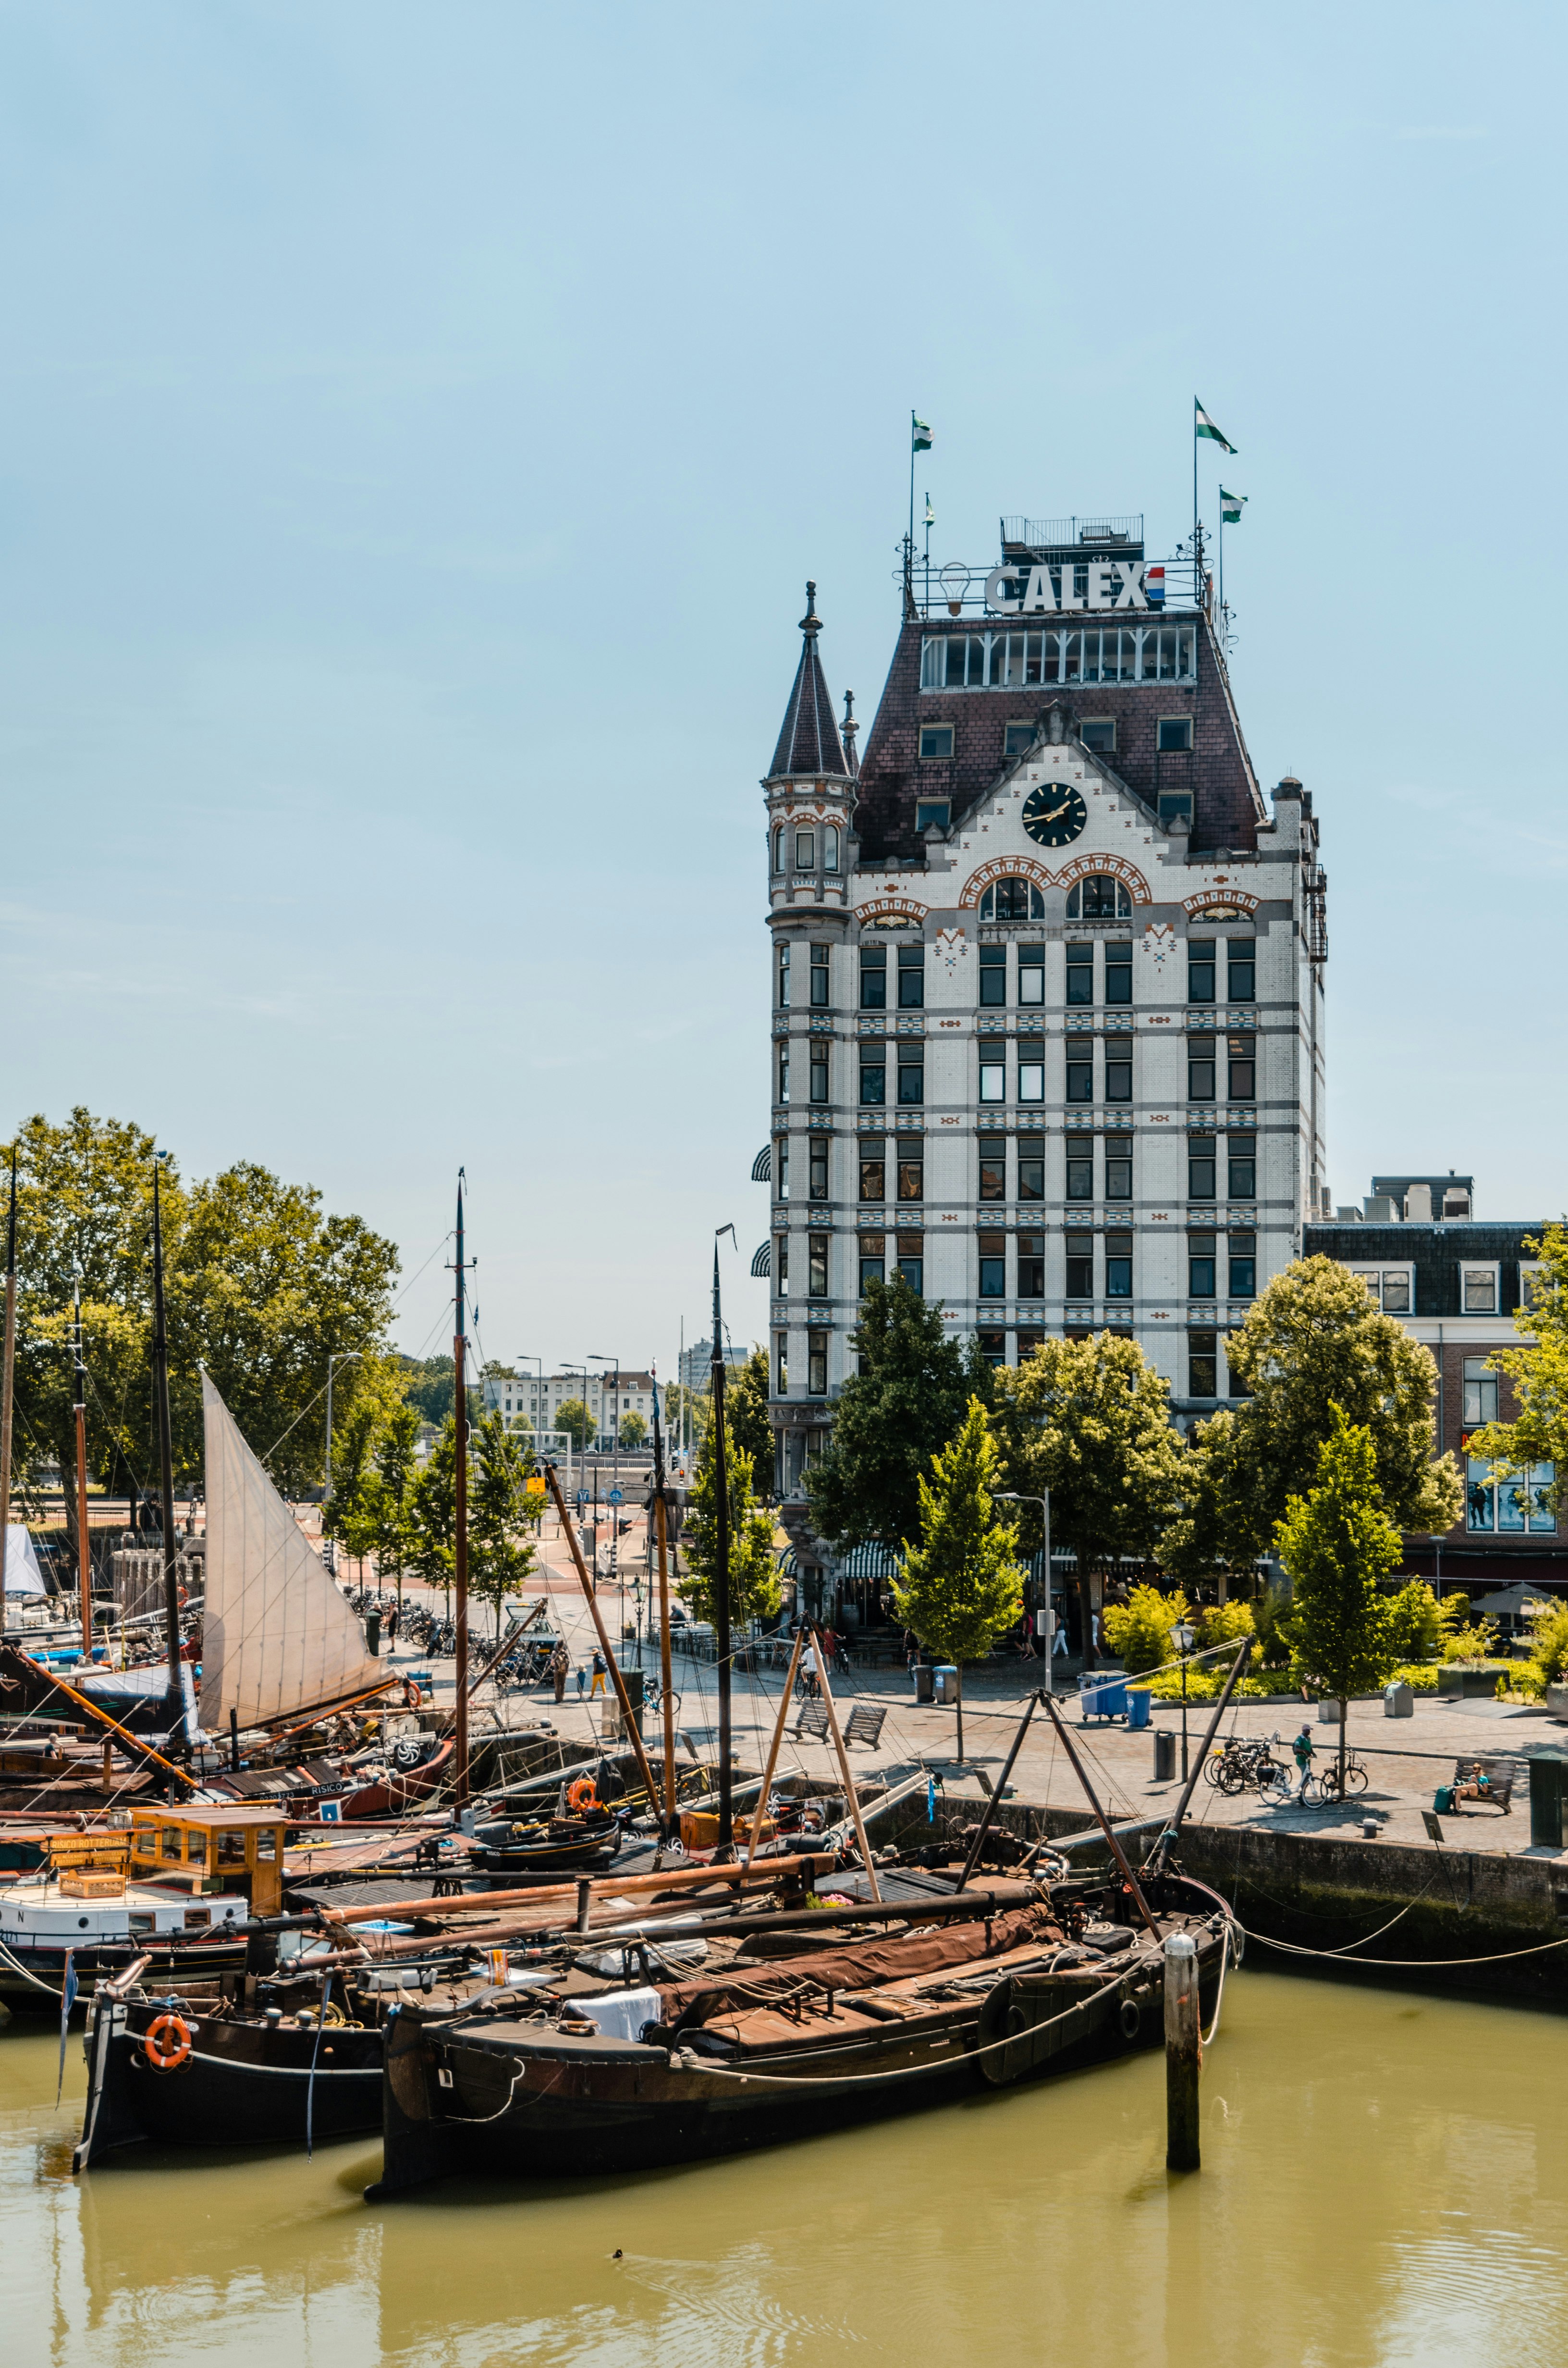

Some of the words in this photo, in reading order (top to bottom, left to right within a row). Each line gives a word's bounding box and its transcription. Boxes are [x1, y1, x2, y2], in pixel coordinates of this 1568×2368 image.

[984, 561, 1149, 613] CALEX
[312, 1783, 343, 1794] RISICO
[52, 1840, 76, 1849] RISICO
[79, 1838, 127, 1848] ROTTERDAM
